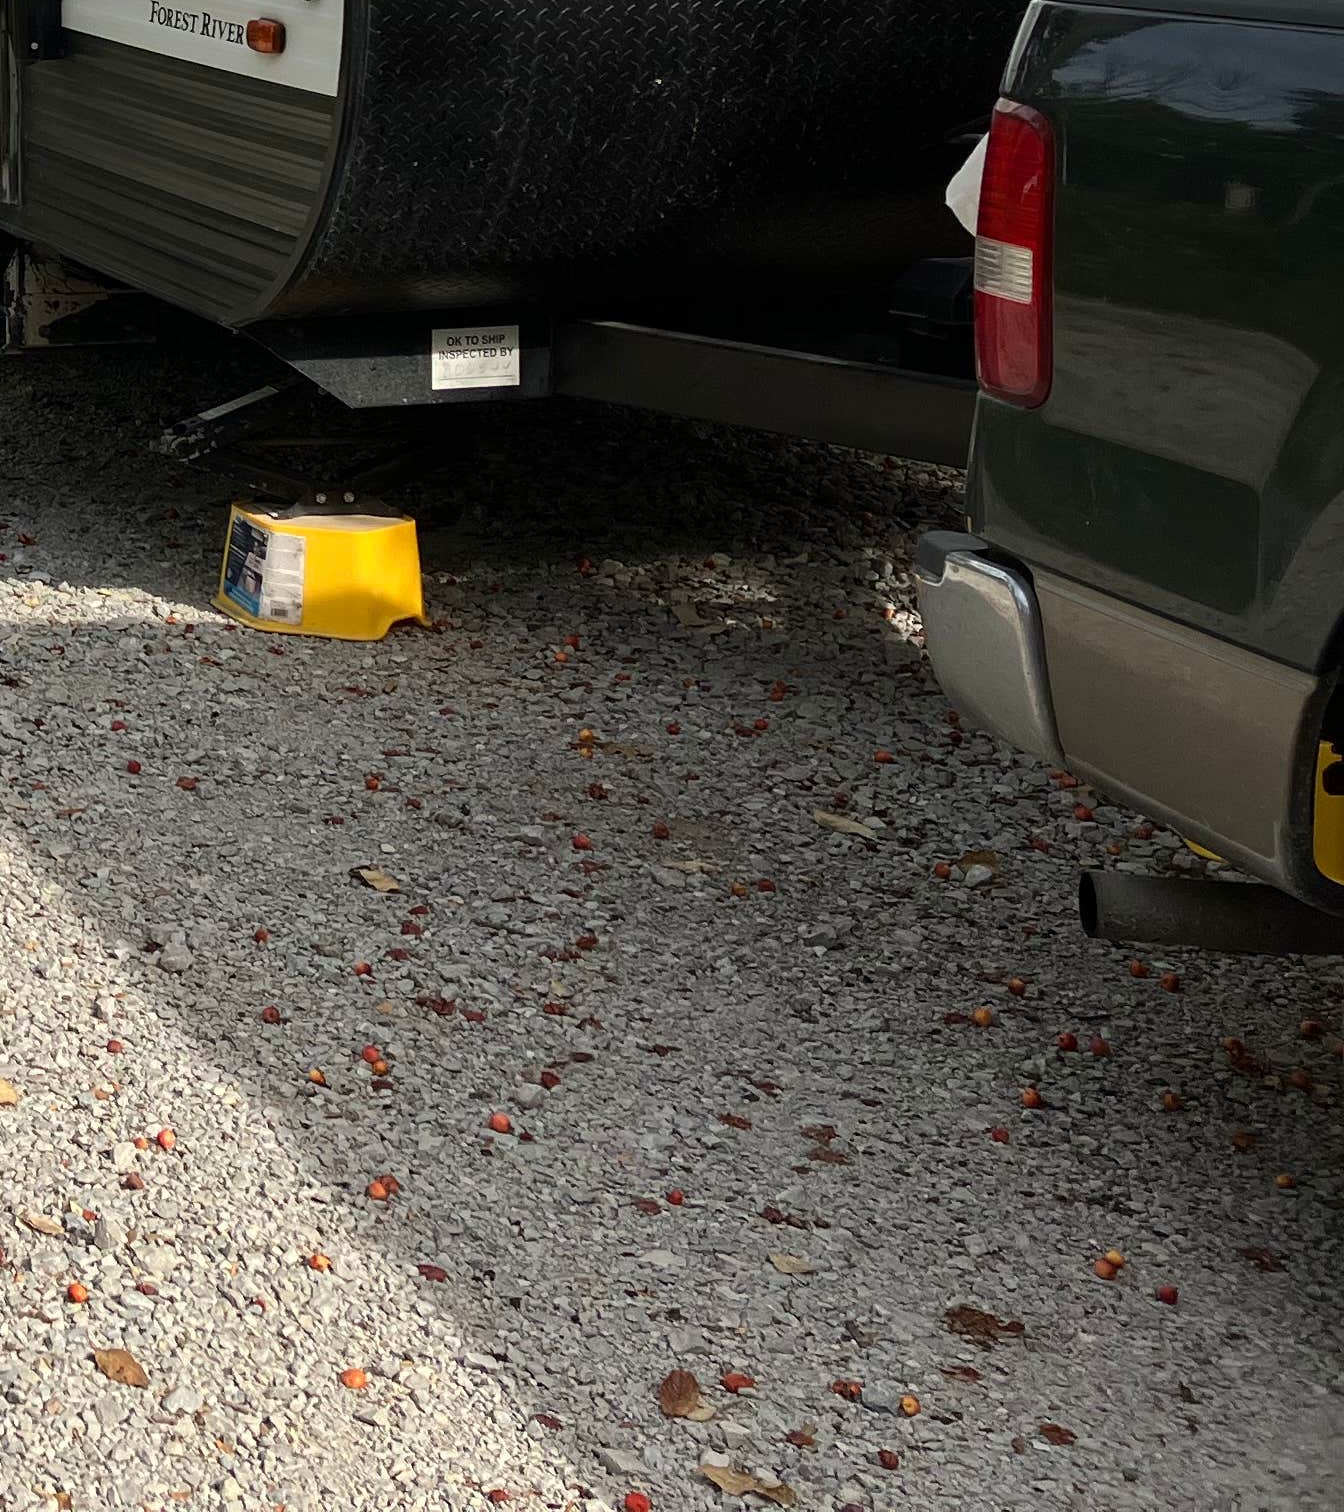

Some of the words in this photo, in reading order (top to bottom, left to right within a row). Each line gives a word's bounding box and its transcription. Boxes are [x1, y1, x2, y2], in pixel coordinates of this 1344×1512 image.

[148, 0, 200, 34] FOREST
[199, 11, 245, 45] RIVER
[447, 336, 463, 346] OK
[464, 334, 480, 346] TO
[481, 333, 506, 345] SHIP
[438, 348, 497, 360] INSPECTED
[499, 346, 514, 357] BY
